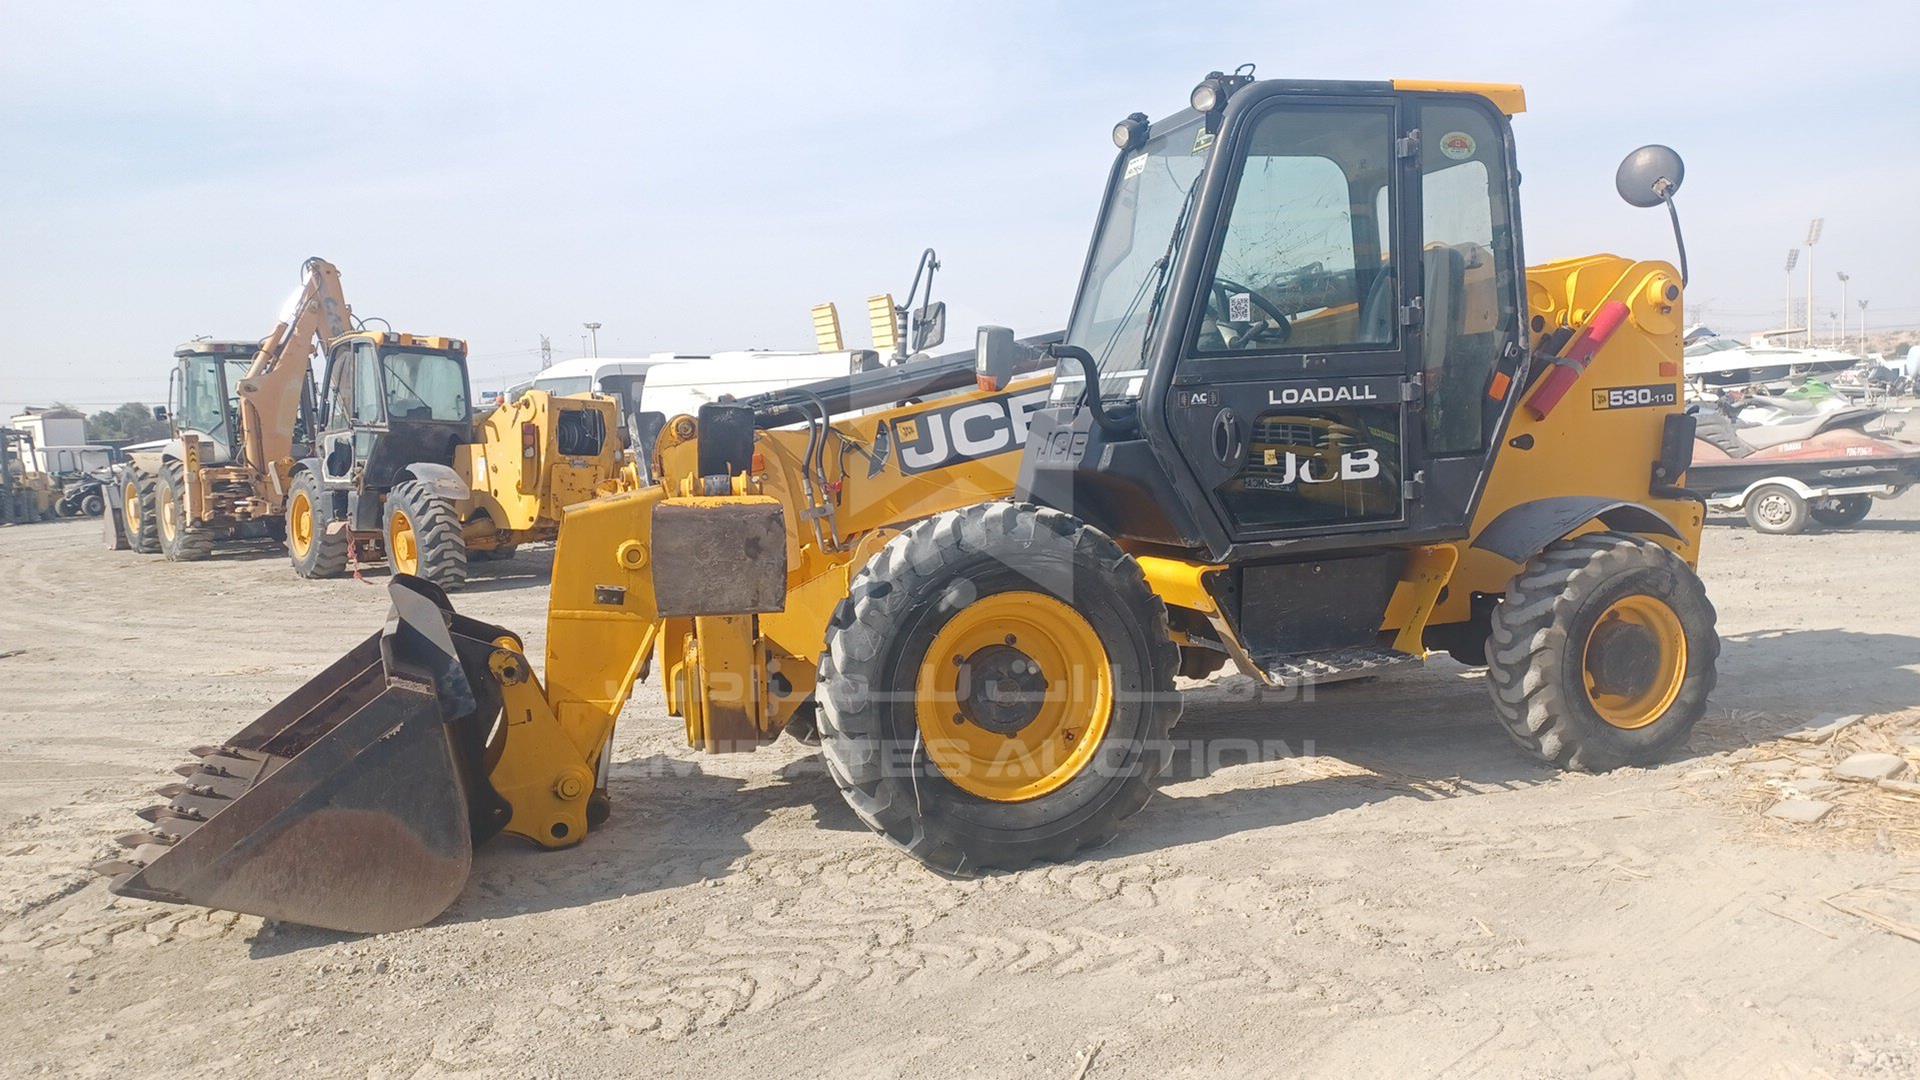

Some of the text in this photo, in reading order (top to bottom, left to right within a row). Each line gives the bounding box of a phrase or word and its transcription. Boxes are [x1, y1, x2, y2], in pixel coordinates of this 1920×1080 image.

[1191, 393, 1208, 403] AC
[1269, 385, 1377, 405] LOADALL
[1610, 389, 1674, 406] 530-110
[1265, 449, 1380, 485] JCB
